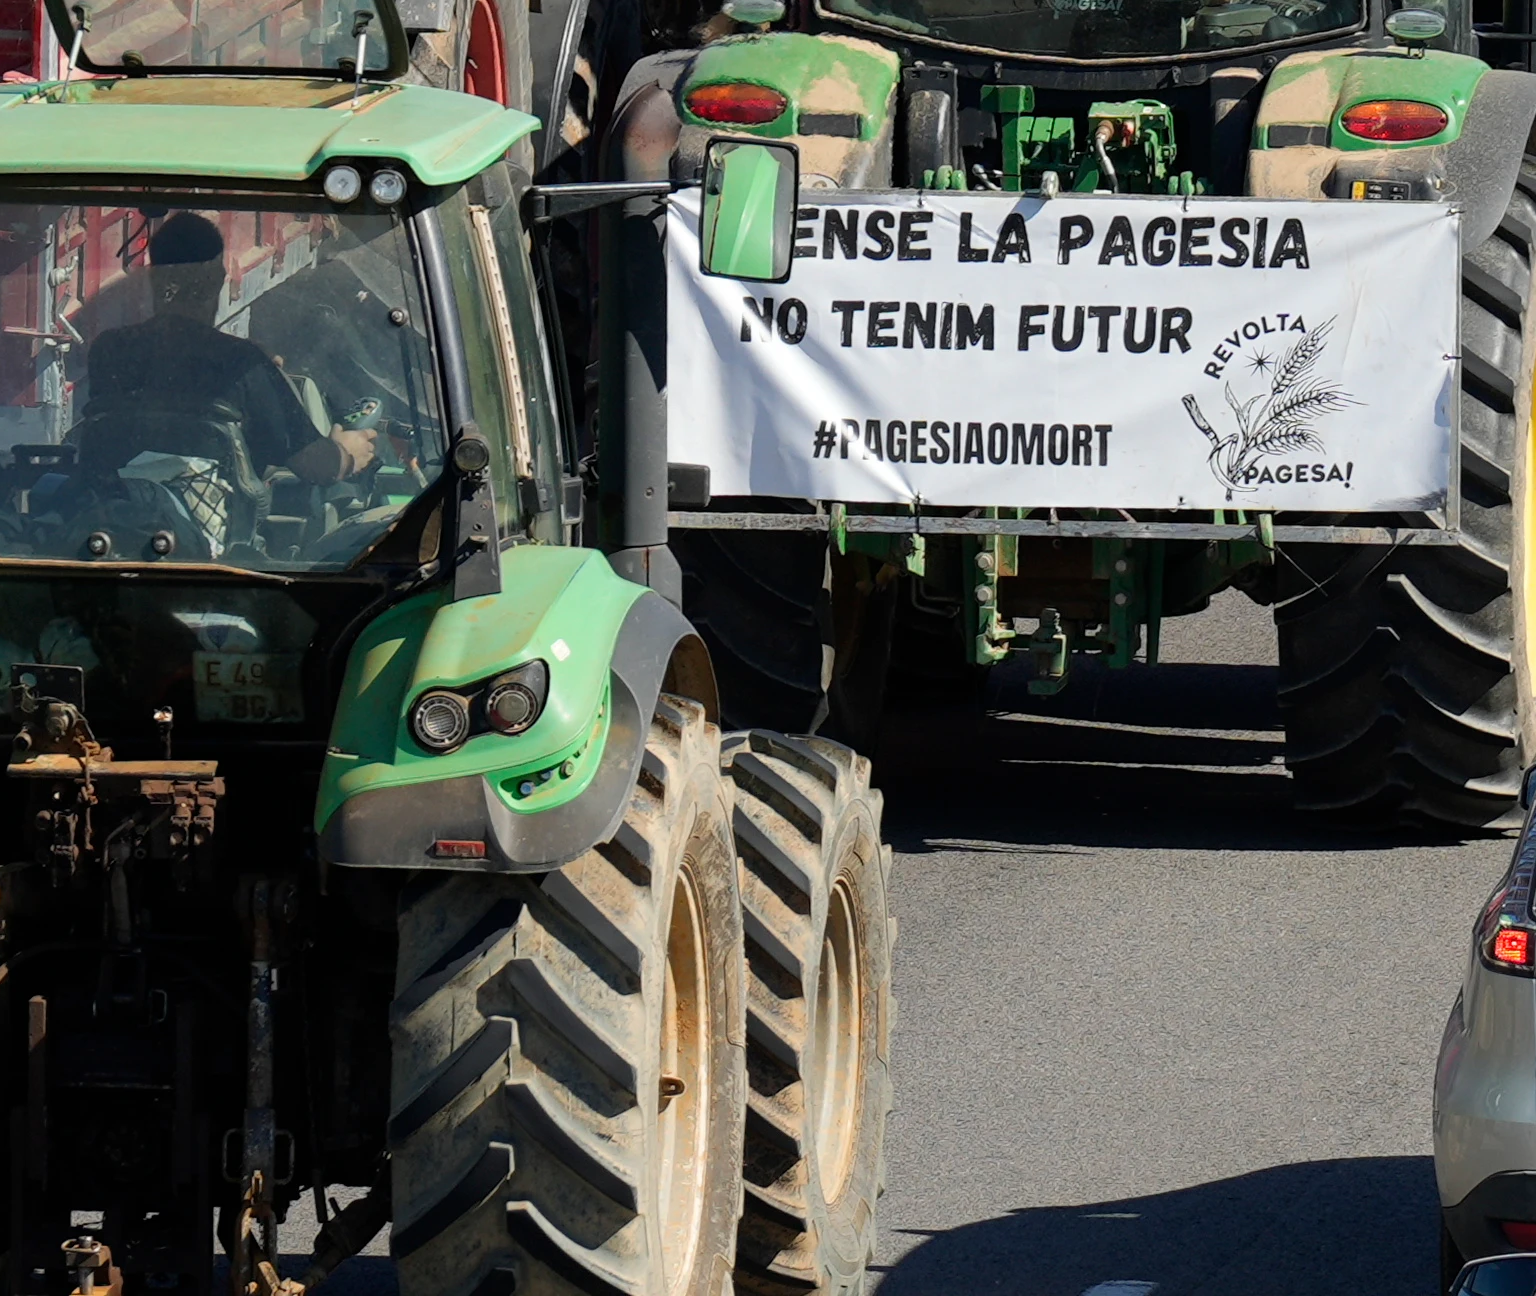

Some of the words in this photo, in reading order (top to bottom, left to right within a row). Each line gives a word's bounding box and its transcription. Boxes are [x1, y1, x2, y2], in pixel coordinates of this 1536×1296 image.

[793, 208, 934, 261] ENSE
[957, 211, 1032, 264] LA
[1058, 215, 1310, 270] PAGESIA
[740, 296, 808, 345] NO
[831, 300, 995, 351] TENIM
[1017, 304, 1193, 355] FUTUR
[1203, 313, 1307, 380] REVOLTA
[813, 418, 1113, 467] #PAGESIAOMORT
[1244, 461, 1354, 489] PAGESA!
